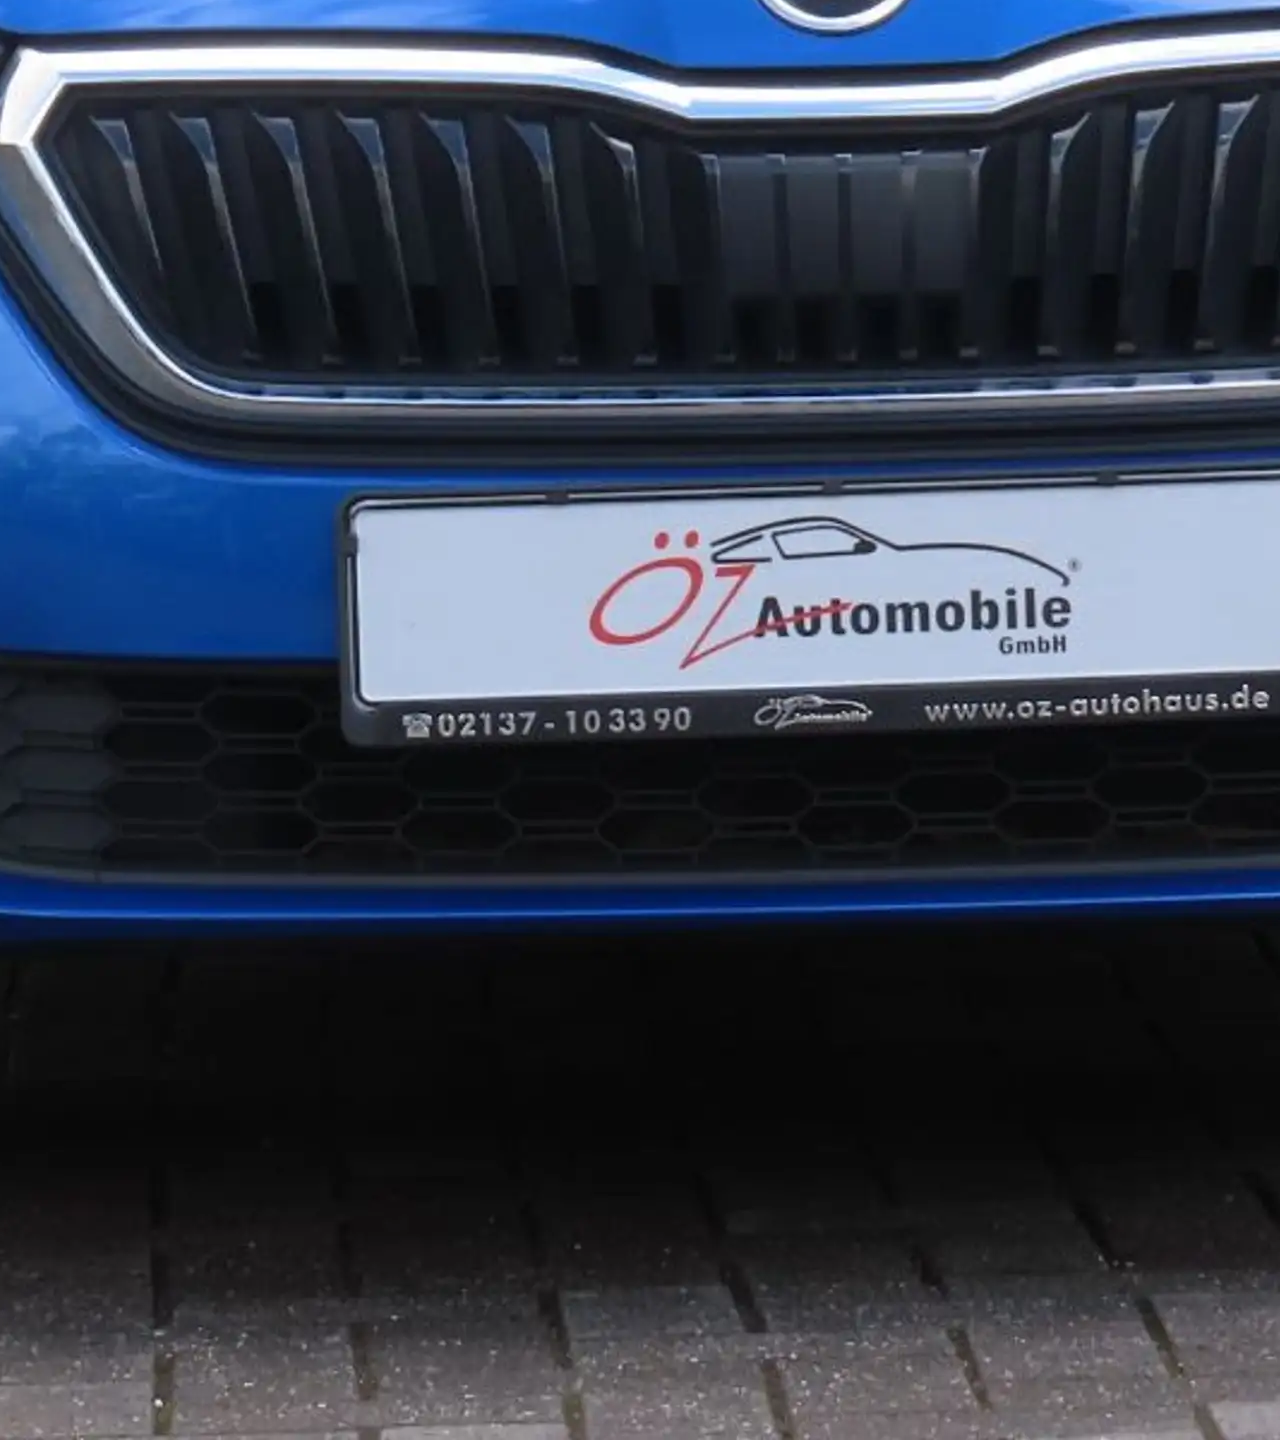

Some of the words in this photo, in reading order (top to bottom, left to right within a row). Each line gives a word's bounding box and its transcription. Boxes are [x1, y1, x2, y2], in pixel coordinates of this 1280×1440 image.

[589, 530, 755, 670] ÖZ
[754, 588, 1071, 638] Automobile
[998, 634, 1067, 655] GmbH
[923, 684, 1270, 723] www.oz-autohaus.de
